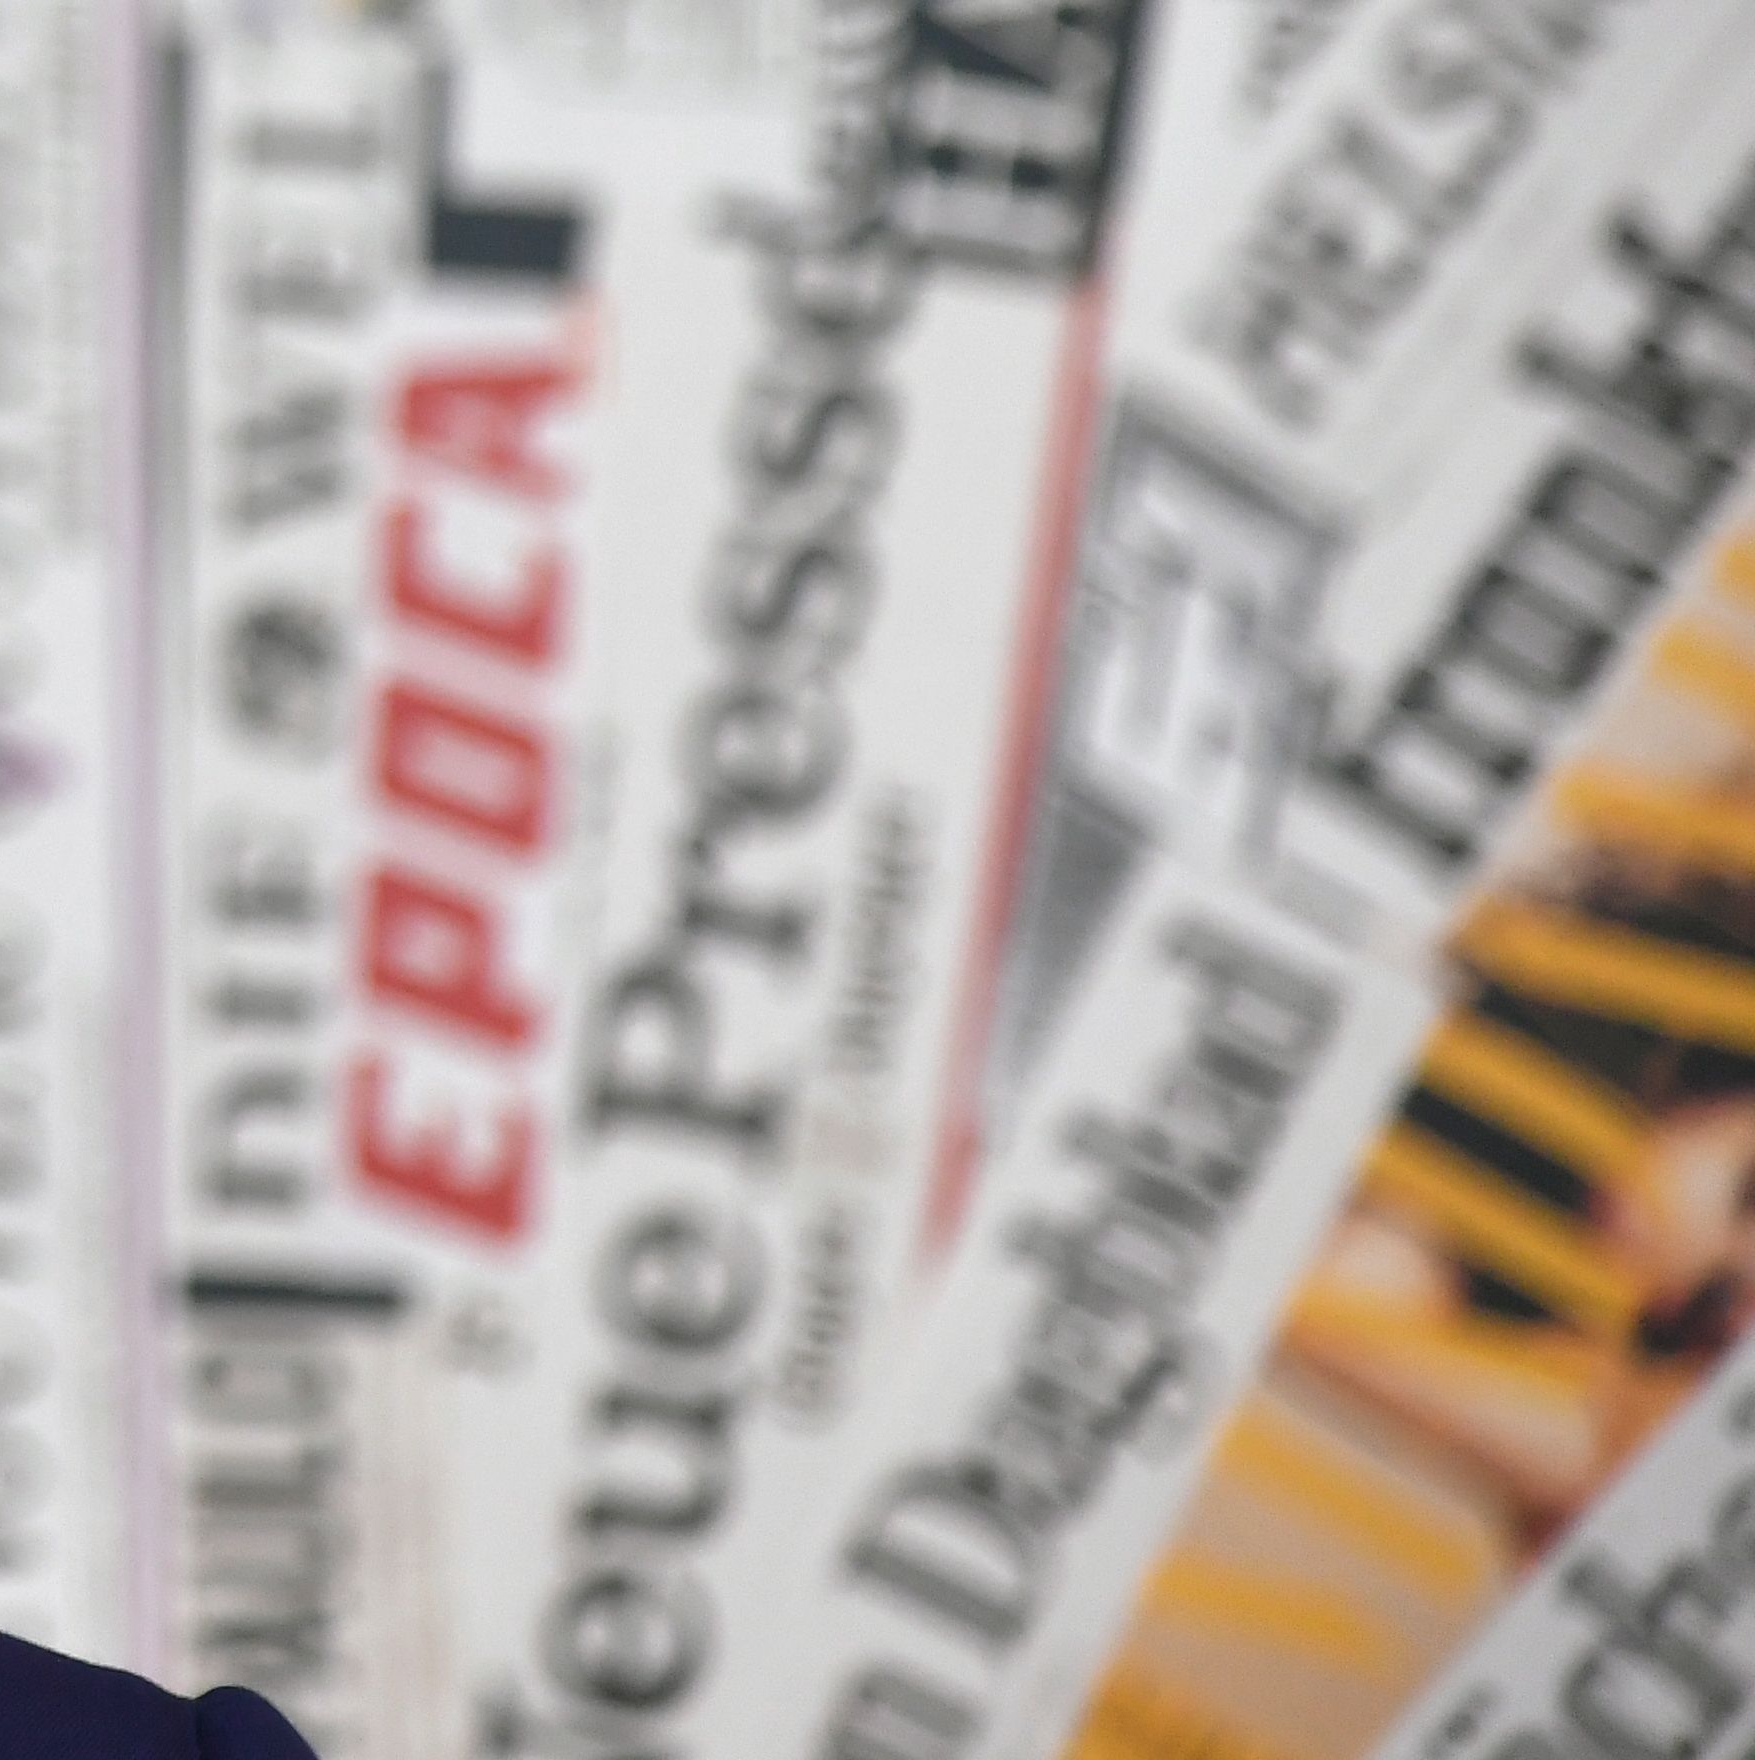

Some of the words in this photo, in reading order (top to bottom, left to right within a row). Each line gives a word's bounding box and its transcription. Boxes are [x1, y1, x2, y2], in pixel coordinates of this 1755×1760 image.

[221, 90, 389, 540] WEL
[199, 817, 331, 1215] DIE
[343, 335, 606, 1243] EPOCA
[481, 1195, 776, 1760] eue
